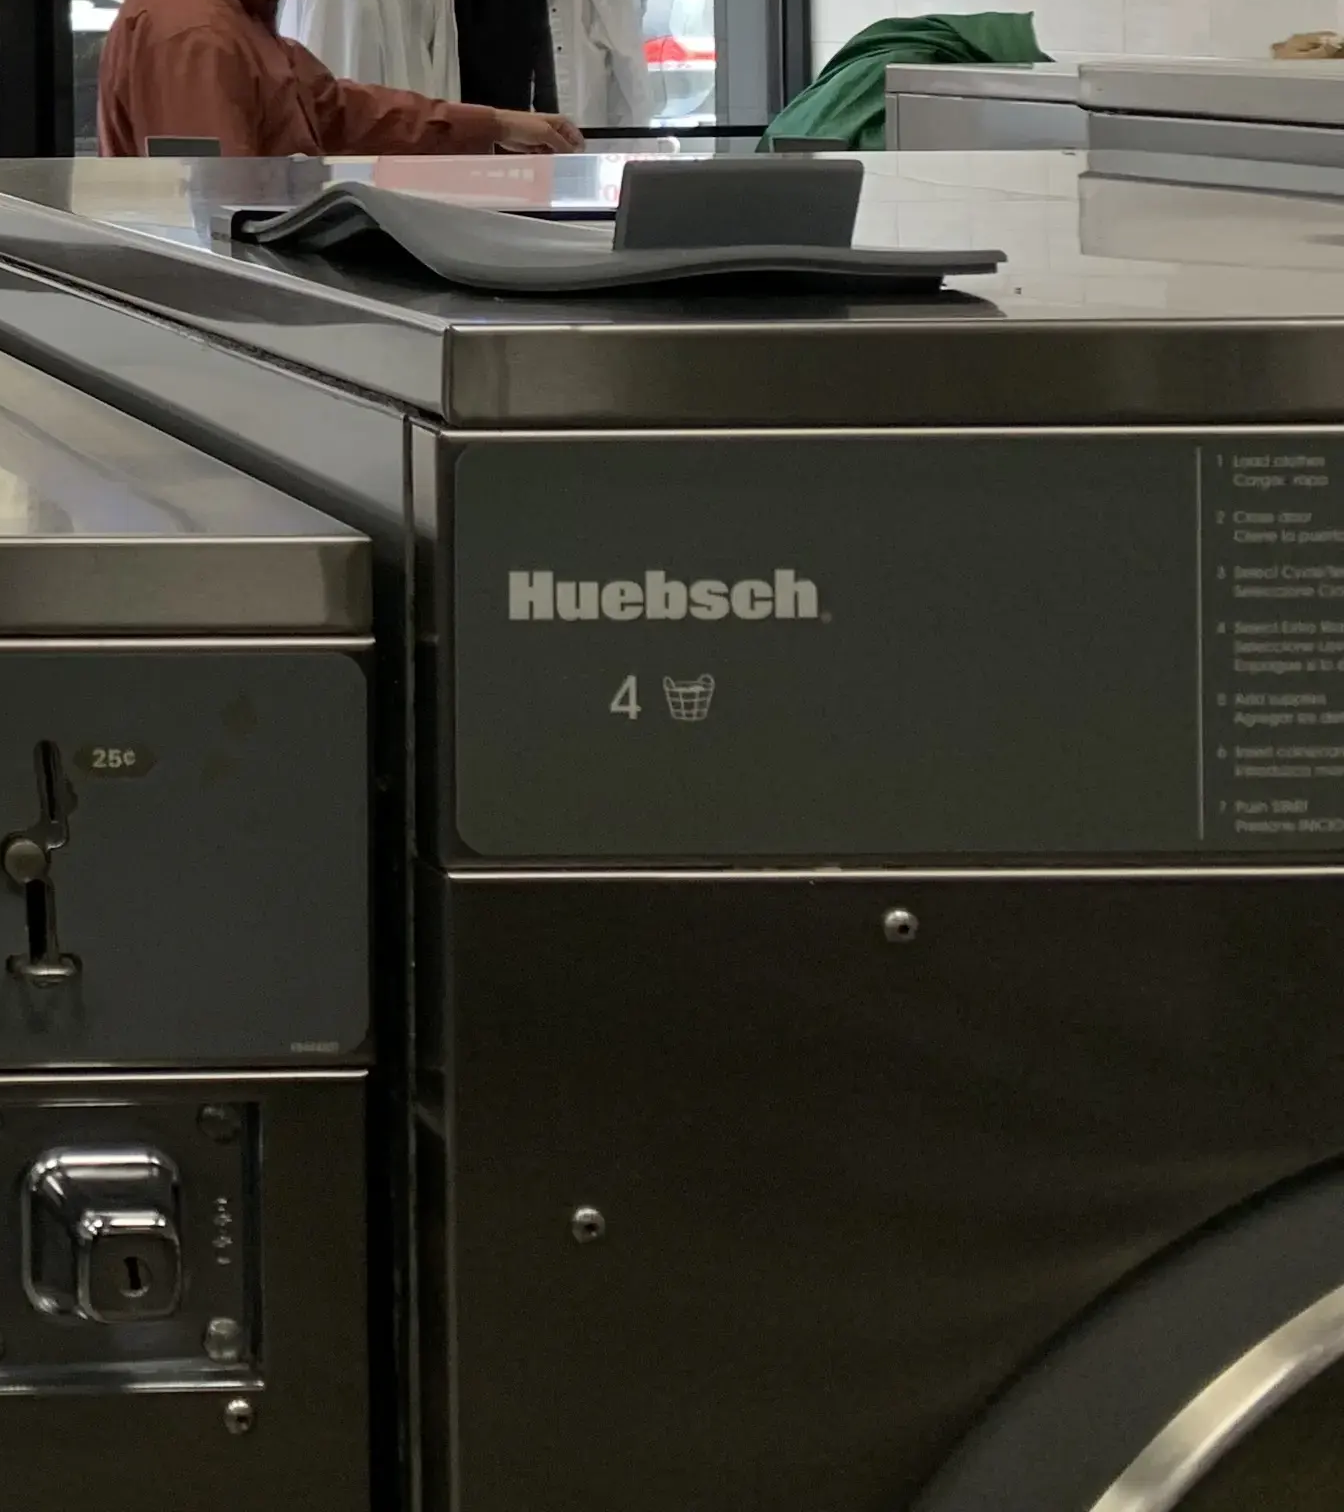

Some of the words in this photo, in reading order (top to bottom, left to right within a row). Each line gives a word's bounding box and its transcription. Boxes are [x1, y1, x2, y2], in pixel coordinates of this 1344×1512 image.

[508, 569, 819, 621] Huebsch
[610, 675, 642, 719] 4
[92, 748, 136, 769] 25¢
